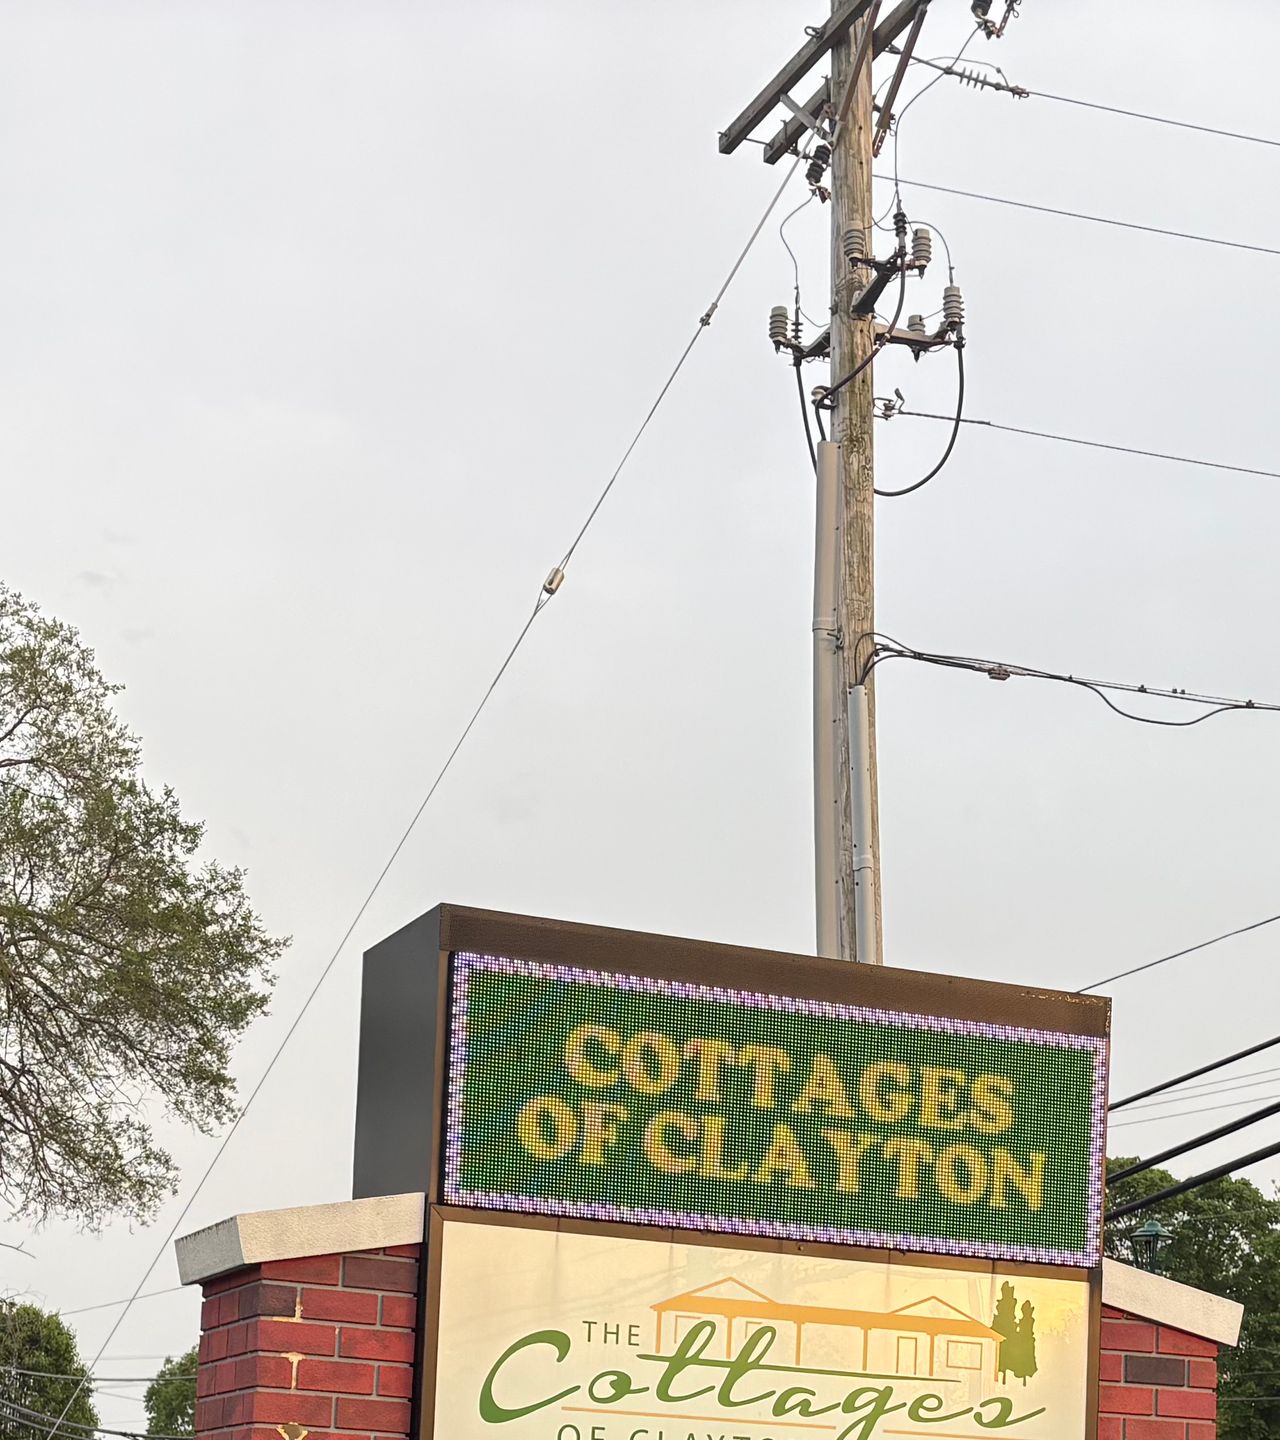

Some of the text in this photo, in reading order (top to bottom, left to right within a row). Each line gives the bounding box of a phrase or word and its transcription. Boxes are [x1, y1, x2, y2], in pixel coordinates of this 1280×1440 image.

[565, 1023, 1016, 1135] COTTAGES
[517, 1095, 1046, 1213] OF CLAYTON
[581, 1320, 641, 1347] THE
